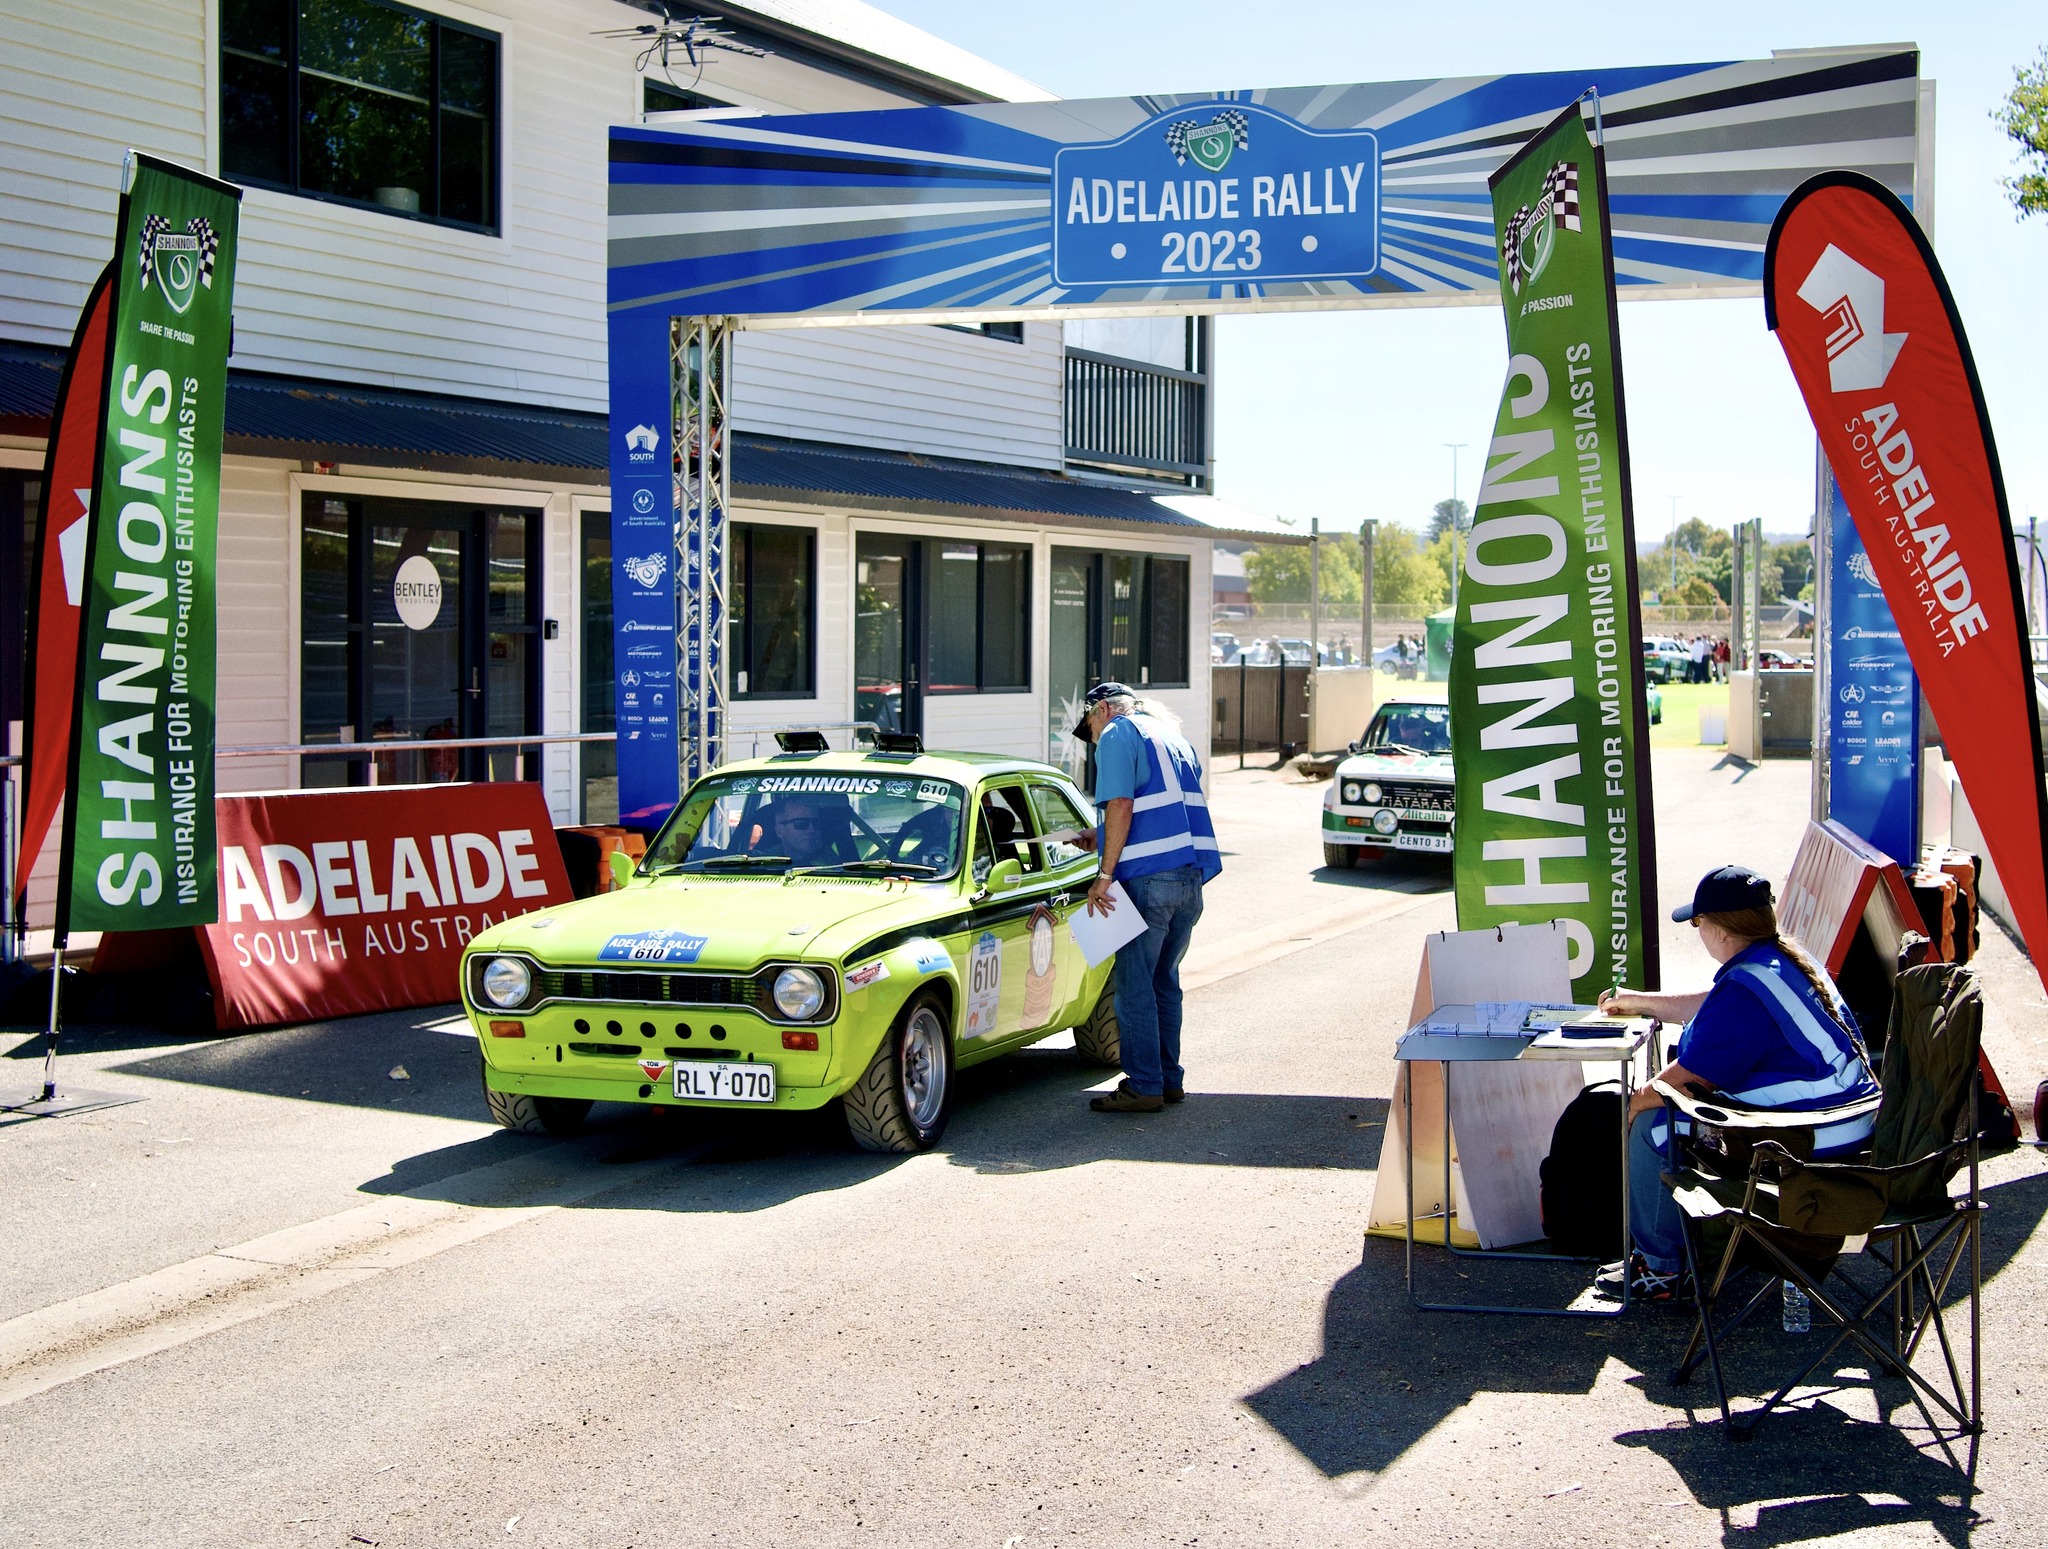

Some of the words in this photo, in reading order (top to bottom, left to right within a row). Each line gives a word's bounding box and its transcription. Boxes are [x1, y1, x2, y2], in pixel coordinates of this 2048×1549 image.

[1188, 124, 1227, 138] SHANNONS
[1066, 177, 1239, 224] ADELAIDE
[1253, 162, 1365, 218] RALLY
[1161, 229, 1262, 273] 2023
[140, 320, 162, 336] SHARE
[163, 326, 173, 340] THE
[1528, 294, 1574, 314] PASSION
[175, 377, 199, 551] ENTHUSIASTS
[1566, 342, 1609, 553] ENTHUSIASTS
[1845, 417, 1890, 506] SOUTH
[1885, 515, 1955, 658] AUSTRALIA
[1861, 402, 1989, 647] ADELAIDE
[395, 582, 441, 596] BENTLEY
[97, 364, 173, 906] SHANNONS
[170, 559, 193, 694] MOTORING
[1586, 562, 1622, 723] MOTORING
[167, 702, 193, 751] FOR
[757, 776, 882, 794] SHANNONS
[920, 784, 948, 796] 610
[1604, 736, 1626, 797] FOR
[169, 760, 199, 904] INSURANCE
[1400, 836, 1431, 847] CENTO
[1436, 839, 1446, 848] 31
[1401, 809, 1446, 820] Alitalia
[221, 829, 549, 923] ADELAIDE
[1607, 807, 1628, 984] INSURANCE
[233, 926, 348, 968] SOUTH
[365, 905, 546, 957] AUSTRA
[608, 938, 663, 948] ADELAIDE
[664, 940, 704, 950] RALLY
[634, 948, 664, 960] 610
[973, 954, 998, 994] 610
